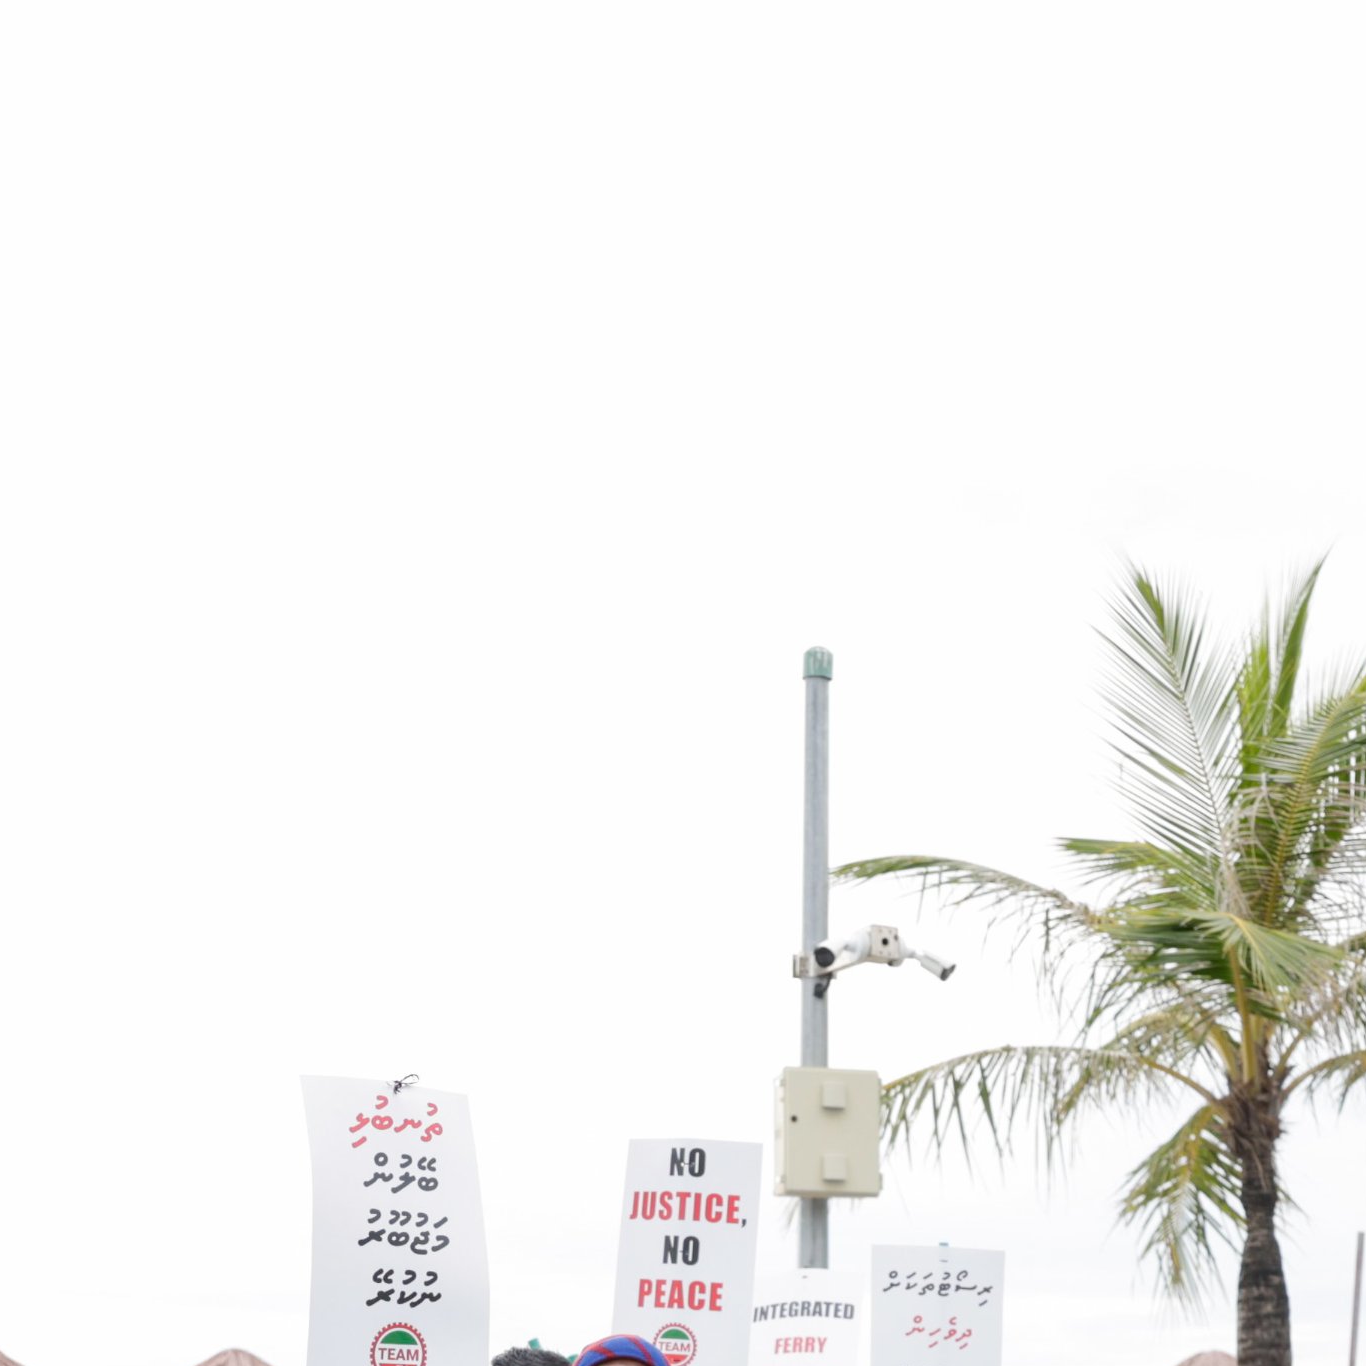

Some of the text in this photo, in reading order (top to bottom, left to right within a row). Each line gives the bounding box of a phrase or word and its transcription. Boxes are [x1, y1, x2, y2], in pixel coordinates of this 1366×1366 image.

[669, 1147, 707, 1178] NO
[629, 1190, 748, 1228] JUSTICE,
[662, 1235, 701, 1266] NO
[637, 1279, 724, 1312] PEACE
[753, 1300, 856, 1323] INTEGRATED
[378, 1347, 420, 1362] TEAM
[658, 1341, 692, 1353] TEAM
[774, 1336, 828, 1355] FERRY
